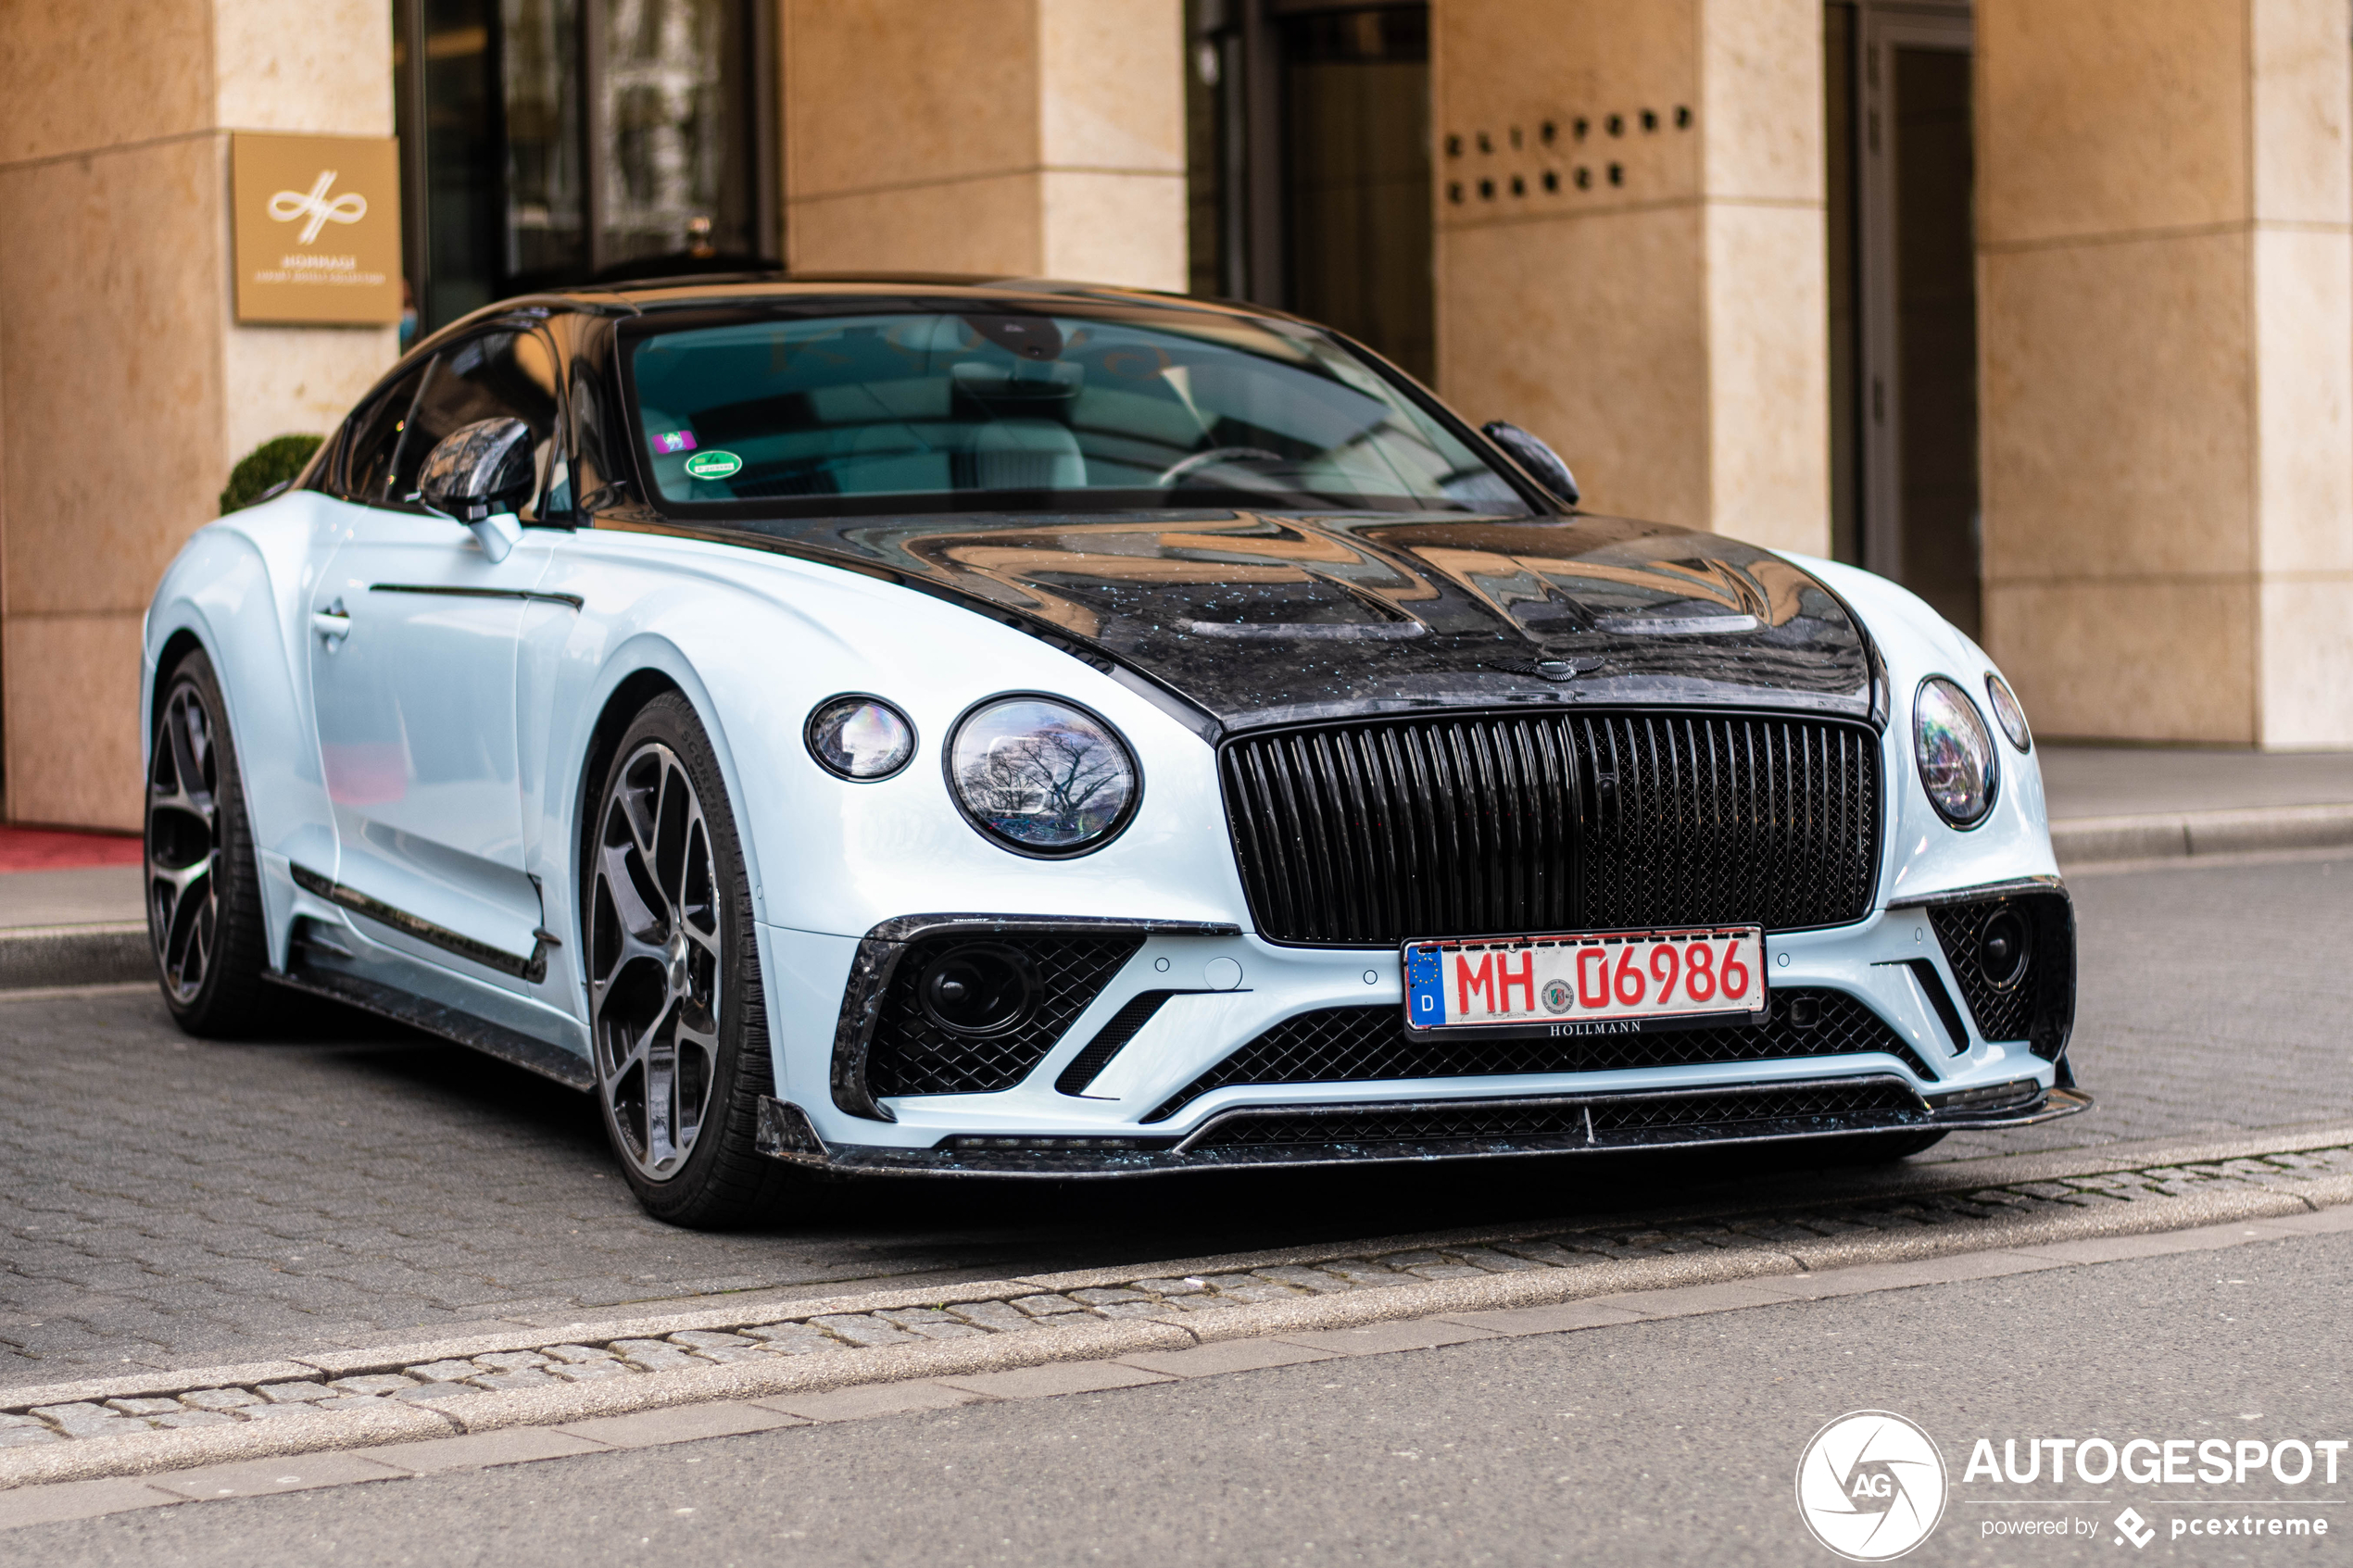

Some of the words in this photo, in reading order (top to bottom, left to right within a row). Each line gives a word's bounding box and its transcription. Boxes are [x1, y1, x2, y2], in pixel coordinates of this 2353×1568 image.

[1455, 949, 1535, 1015] MH
[1576, 939, 1749, 1009] 06986
[1421, 995, 1434, 1012] D
[1550, 1021, 1642, 1036] HOLLMANN
